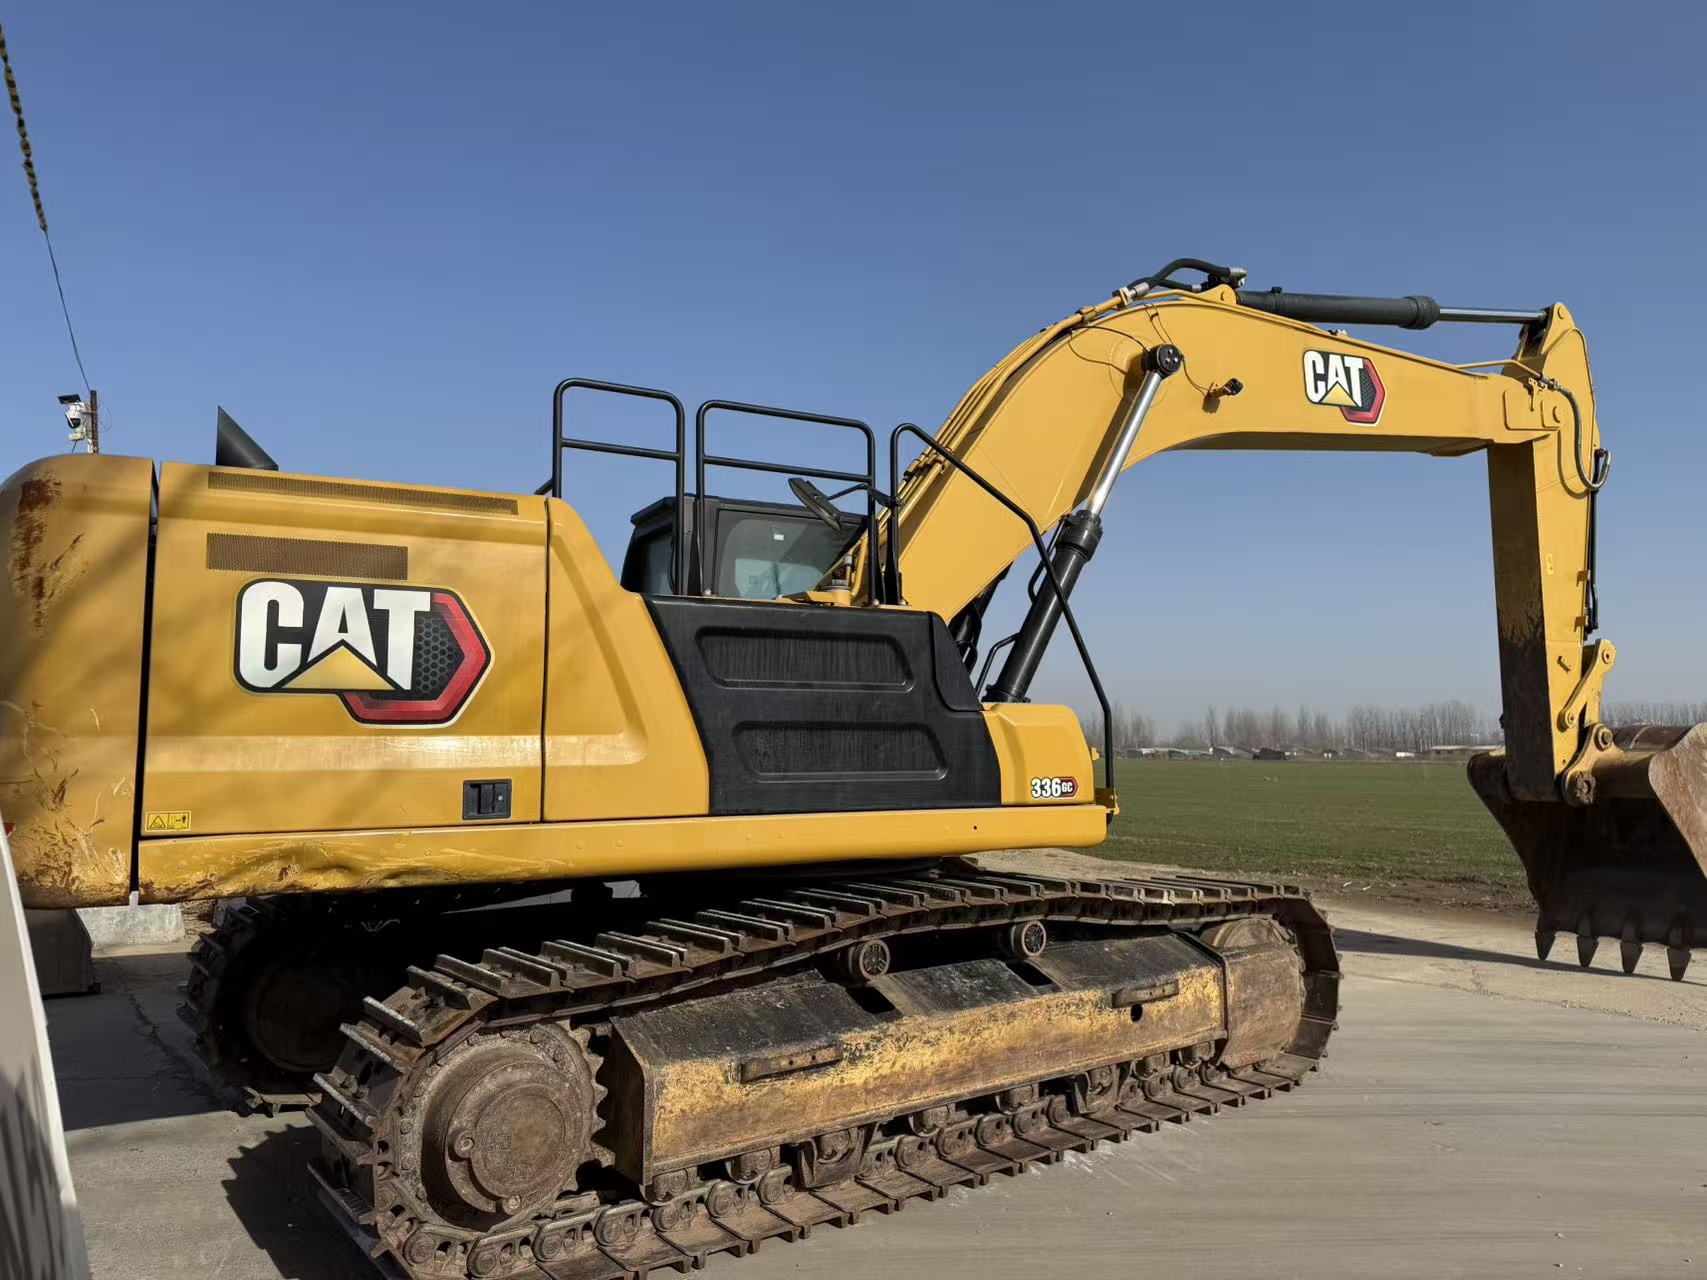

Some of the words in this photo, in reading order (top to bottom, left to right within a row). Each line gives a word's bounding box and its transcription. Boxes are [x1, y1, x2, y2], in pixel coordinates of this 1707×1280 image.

[1304, 350, 1364, 408] CAT
[239, 581, 431, 690] CAT
[1031, 778, 1062, 798] 336
[1062, 782, 1073, 793] GC
